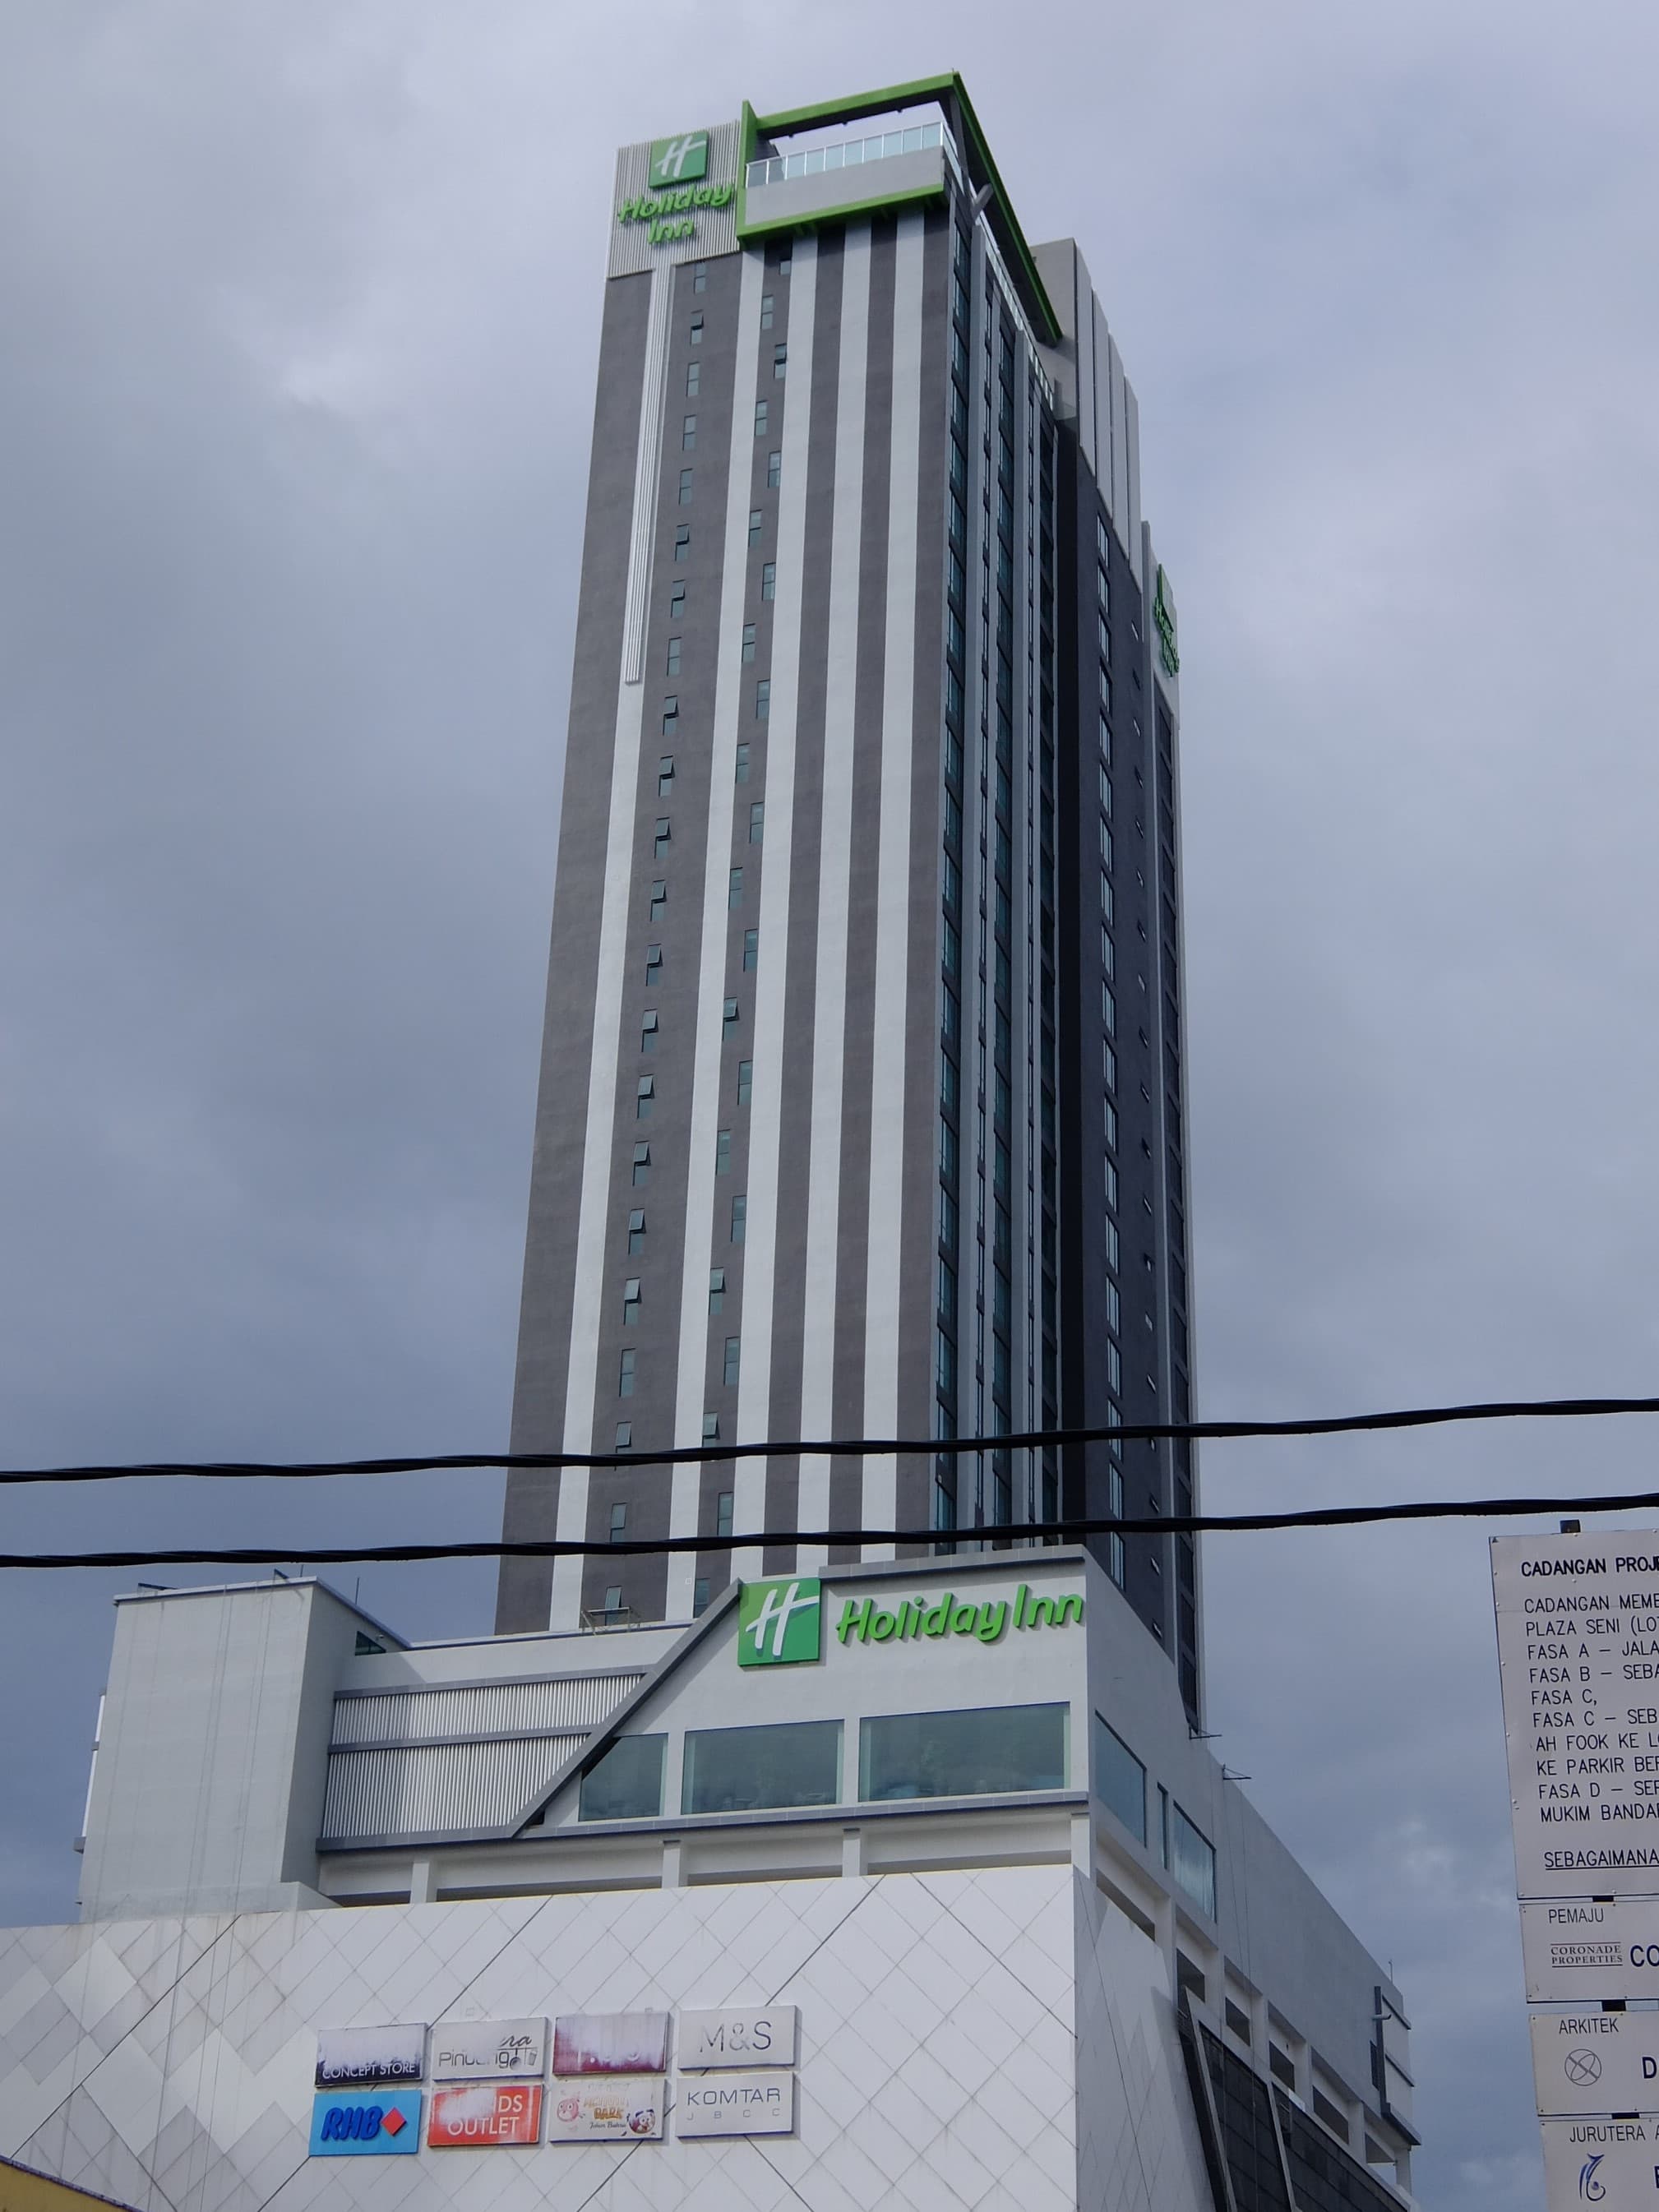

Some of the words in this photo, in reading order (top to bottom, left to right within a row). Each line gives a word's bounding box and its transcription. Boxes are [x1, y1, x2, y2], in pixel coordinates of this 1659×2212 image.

[617, 183, 735, 223] Holiday
[647, 216, 695, 245] Inn
[1521, 1558, 1607, 1577] CADANGAN
[834, 1592, 1007, 1644] Holiday
[1012, 1583, 1085, 1628] Inn
[1524, 1595, 1610, 1614] CADANGAN
[1525, 1619, 1578, 1637] PLAZA
[1585, 1618, 1620, 1635] SENI
[1630, 1614, 1659, 1637] (LO
[1527, 1643, 1569, 1660] FASA
[1578, 1642, 1590, 1658] A
[1529, 1666, 1571, 1684] FASA
[1579, 1665, 1591, 1682] B
[1531, 1689, 1573, 1706] FASA
[1582, 1688, 1597, 1706] C,
[1532, 1711, 1575, 1729] FASA
[1583, 1710, 1595, 1726] C
[1536, 1735, 1557, 1753] AH
[1566, 1734, 1610, 1751] FOOK
[1618, 1732, 1640, 1749] KE
[1536, 1759, 1558, 1776] KE
[1566, 1757, 1625, 1776] PARKIR
[1538, 1782, 1581, 1800] FASA
[1589, 1781, 1601, 1798] D
[1540, 1804, 1591, 1823] MUKIM
[1600, 1802, 1659, 1821] BANDA
[1548, 1907, 1604, 1924] PEMAJU
[1550, 1945, 1621, 1956] CORONADE
[1551, 1955, 1624, 1965] PROPERTIES
[1558, 2017, 1620, 2035] ARKITEK
[700, 2020, 772, 2053] M&S
[322, 2064, 377, 2080] CONCEPT
[380, 2062, 416, 2076] STORE
[687, 2088, 781, 2106] KOMTAR
[321, 2106, 384, 2140] RHB
[448, 2117, 520, 2136] OUTLET
[1569, 2124, 1647, 2143] JURUTERA
